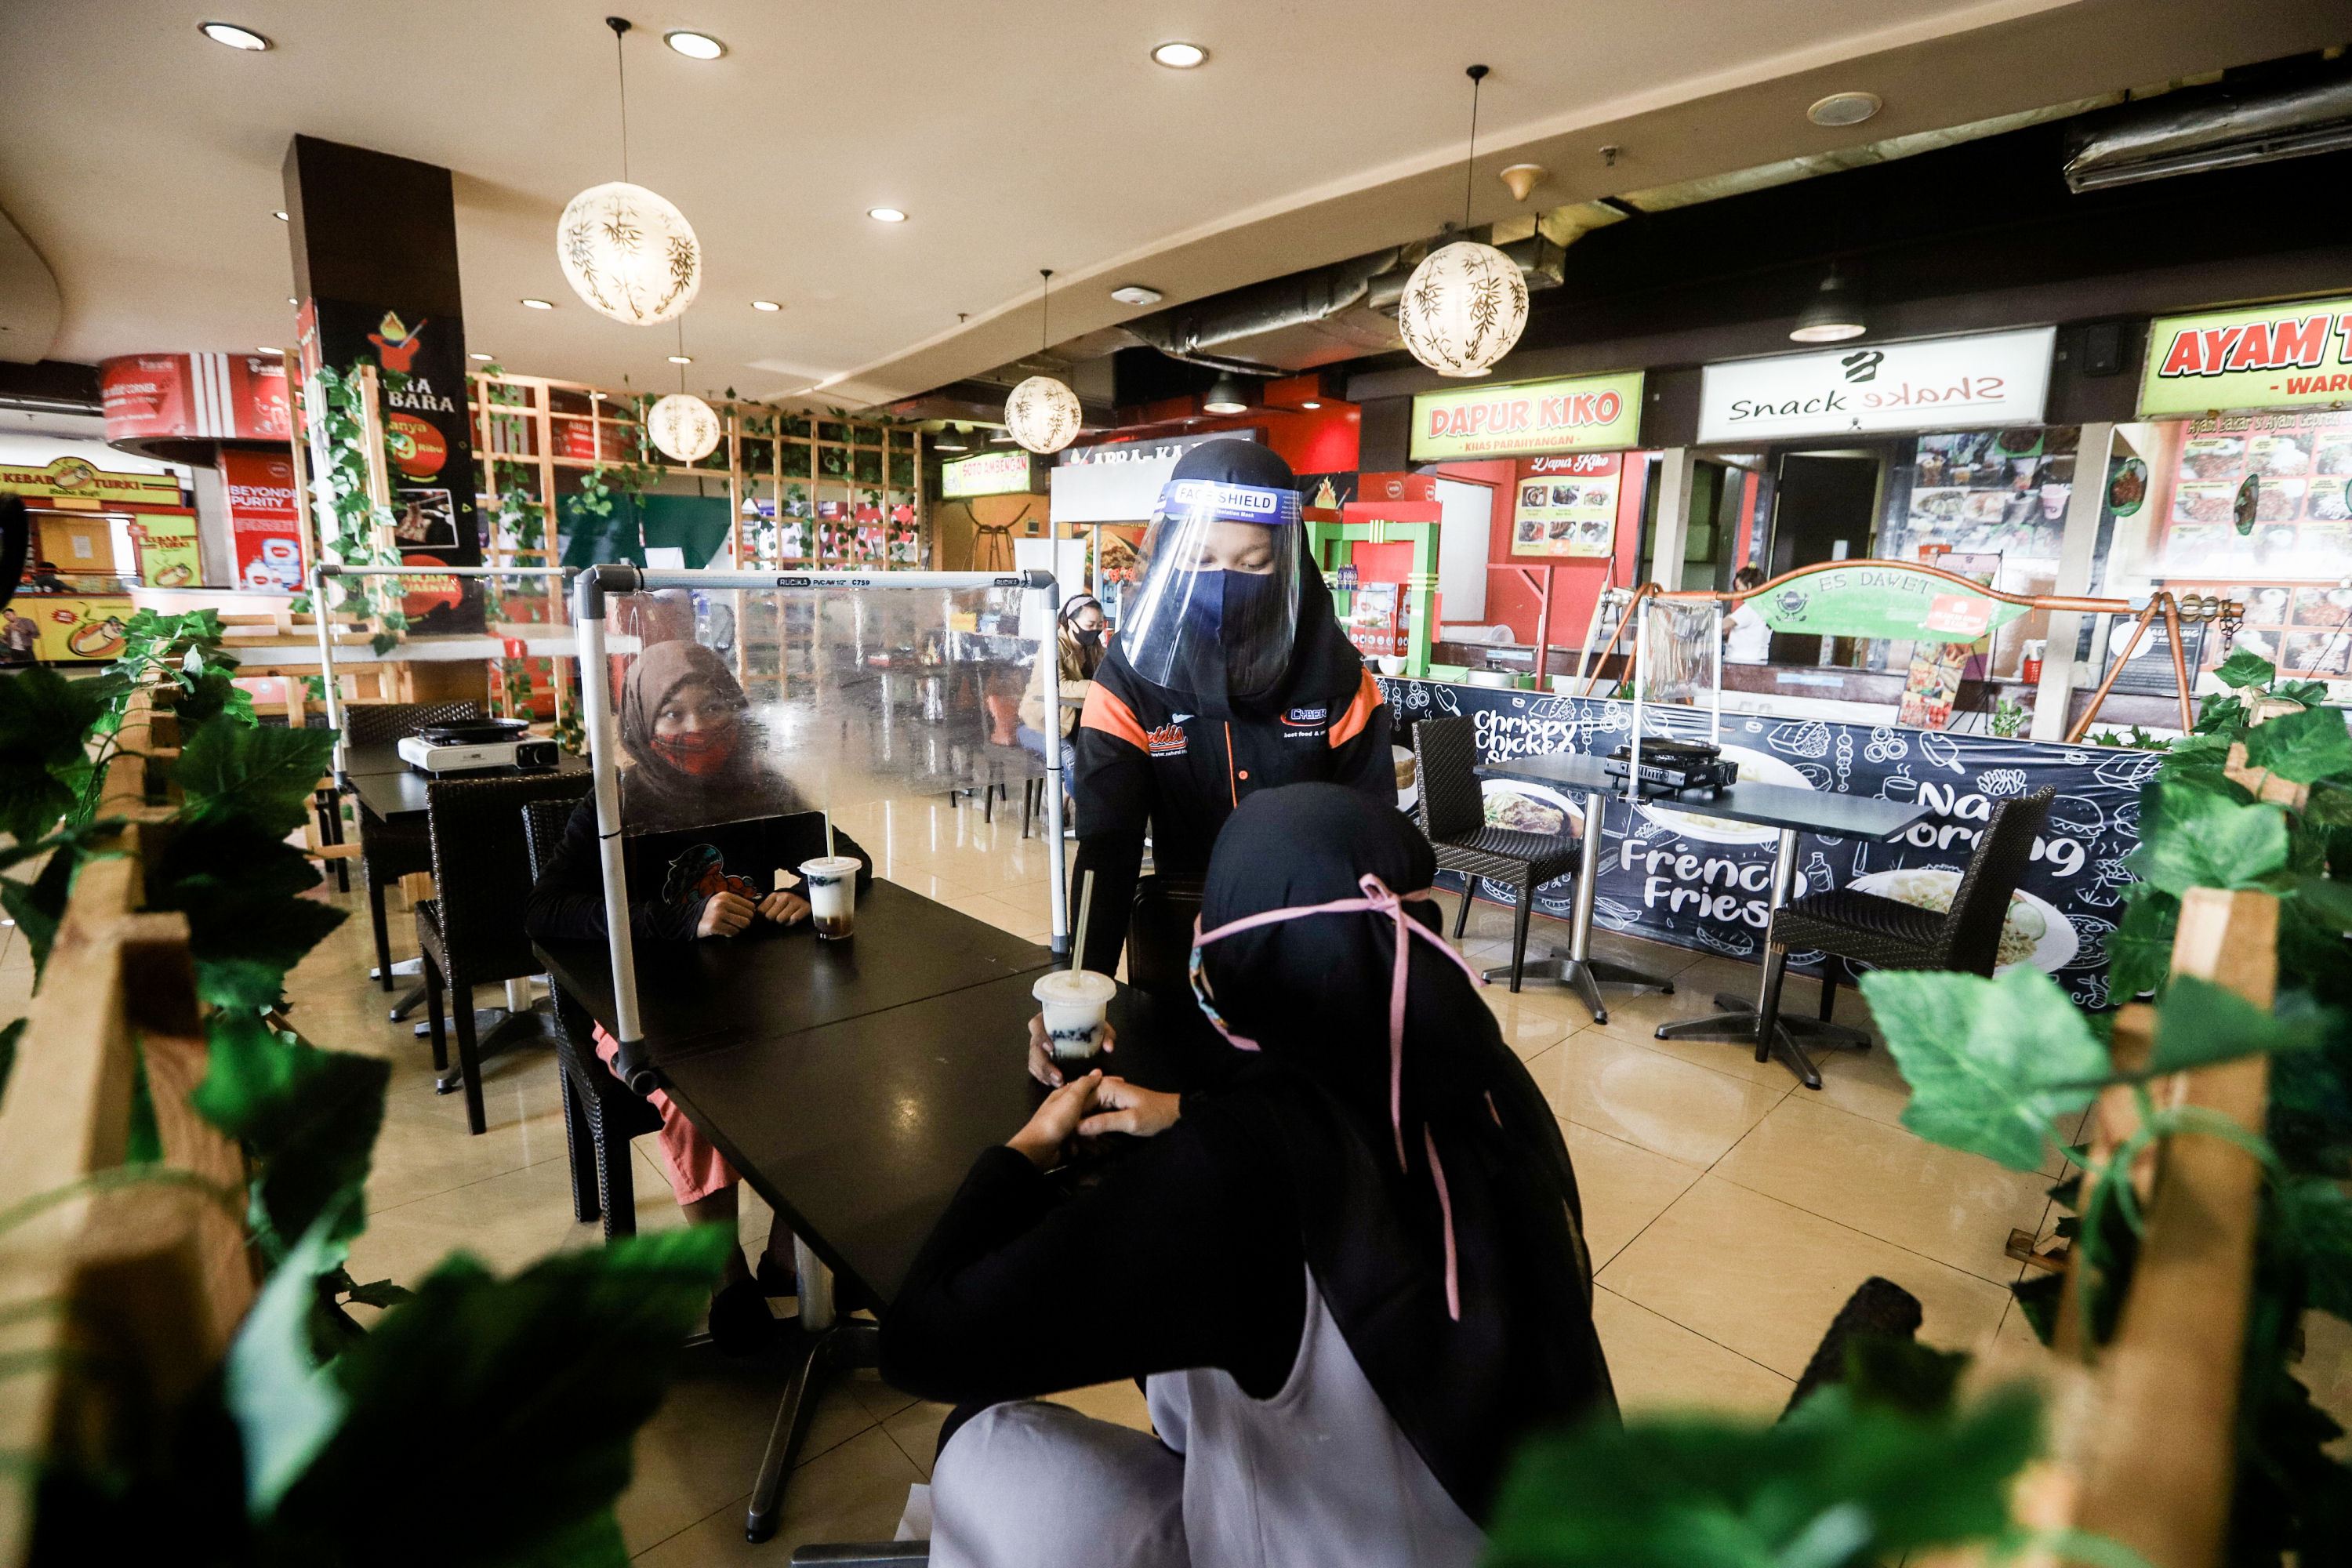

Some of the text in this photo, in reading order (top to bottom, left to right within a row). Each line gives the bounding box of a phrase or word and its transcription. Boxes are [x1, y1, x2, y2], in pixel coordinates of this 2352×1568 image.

[2158, 313, 2334, 378] AYAM
[388, 390, 455, 412] BARA
[1729, 390, 1847, 420] Snack
[1429, 390, 1622, 439] DAPUR KIKO
[388, 421, 427, 435] anya
[1465, 435, 1574, 452] KHAS PARAHYANGAN
[963, 461, 982, 477] SOTO
[1531, 454, 1610, 472] Dapur Kiko
[3, 472, 140, 490] KEBAB TURKI
[230, 485, 292, 499] BEYOND
[231, 495, 283, 507] PURITY
[1218, 492, 1271, 509] SHIELD
[1819, 573, 1847, 592] ES
[1474, 710, 1578, 744] Chrispy
[1475, 729, 1577, 756] Chicken
[1918, 781, 1994, 822] Na
[1644, 876, 1769, 928] Fries
